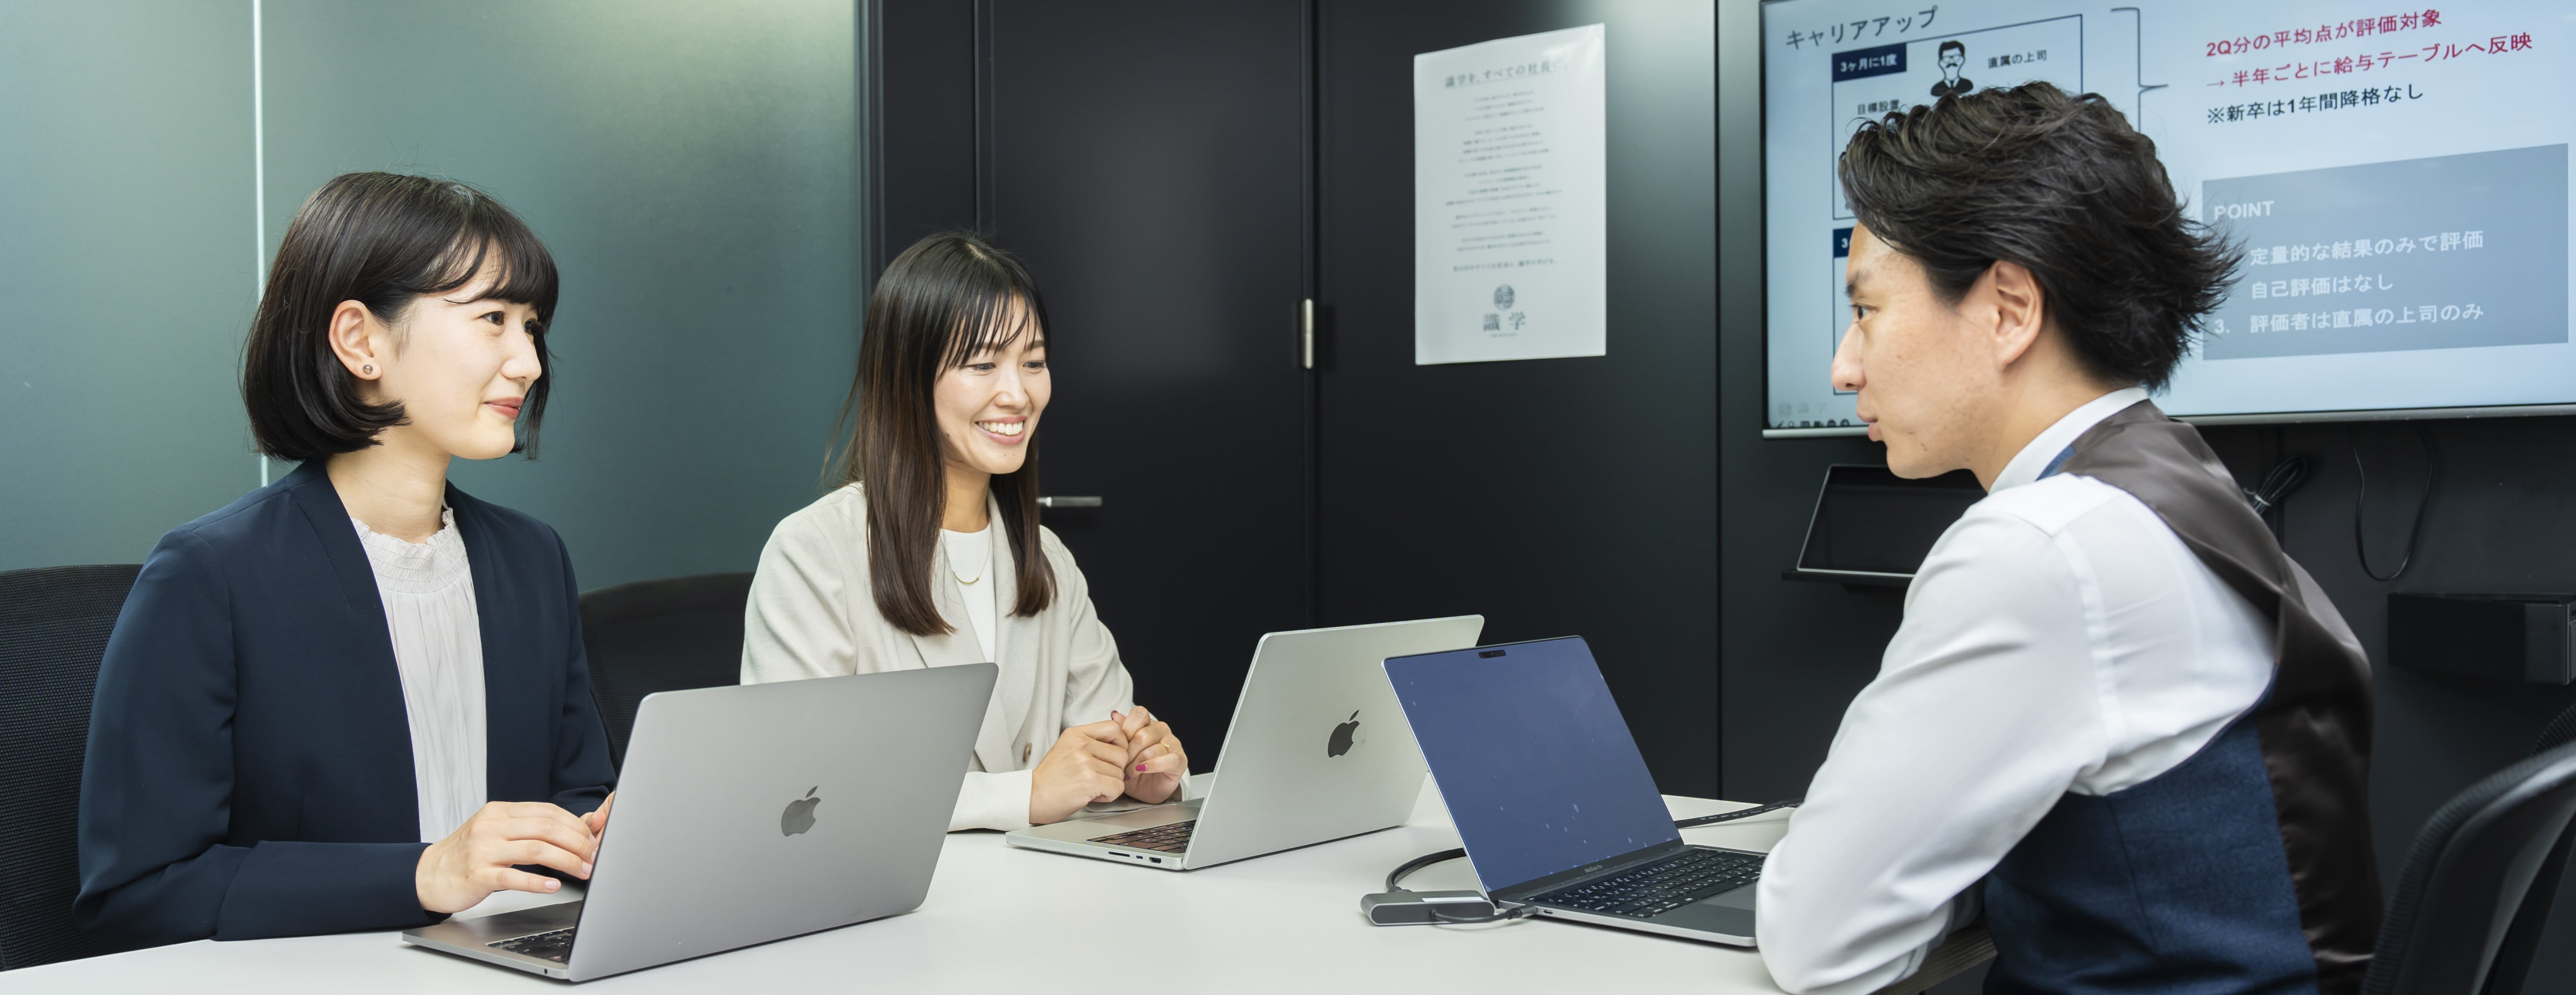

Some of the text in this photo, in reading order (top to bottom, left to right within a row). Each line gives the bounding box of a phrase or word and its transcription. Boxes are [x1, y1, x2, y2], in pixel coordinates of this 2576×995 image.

[1785, 5, 1939, 51] キャリアアップ
[2206, 9, 2442, 58] 2Q分の平均点が評価対象
[1988, 49, 2047, 69] 直属の上司
[2231, 32, 2533, 88] 半年ごとに給与テーブルへ反映
[2214, 200, 2275, 221] POINT
[2250, 230, 2484, 266] 定量的な結果のみで評価
[2251, 273, 2394, 300] 自己評価はなし
[2250, 302, 2484, 334] 評価者は直属の上司のみ
